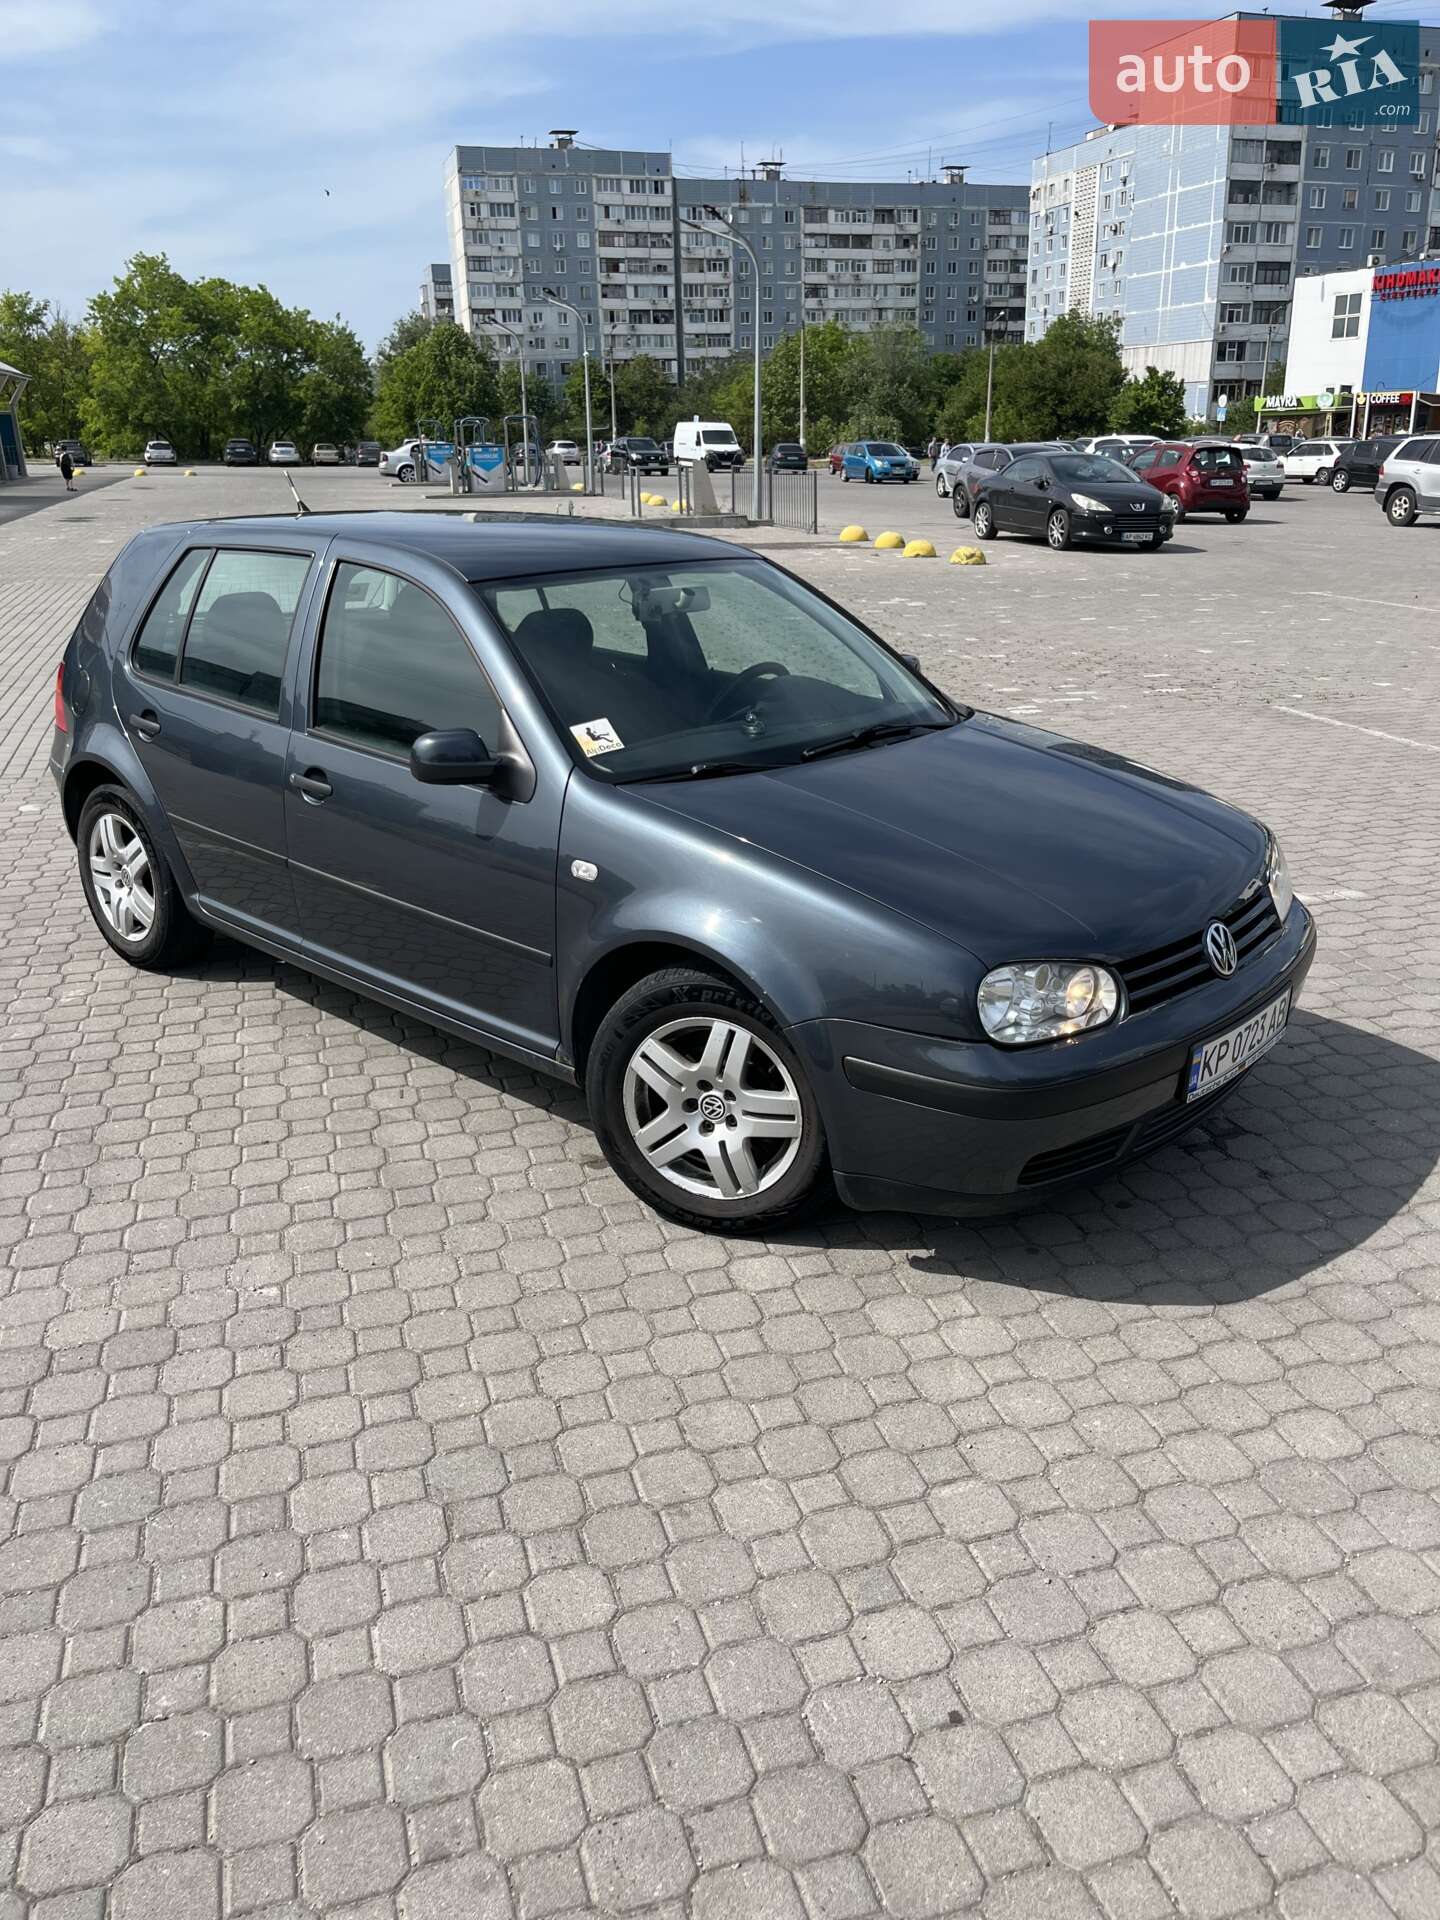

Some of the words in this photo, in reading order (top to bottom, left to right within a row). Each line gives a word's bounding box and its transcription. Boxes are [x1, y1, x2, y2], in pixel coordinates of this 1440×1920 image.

[1370, 393, 1400, 404] COFFEE
[1200, 1039, 1230, 1081] KP
[1231, 1012, 1268, 1063] 0723
